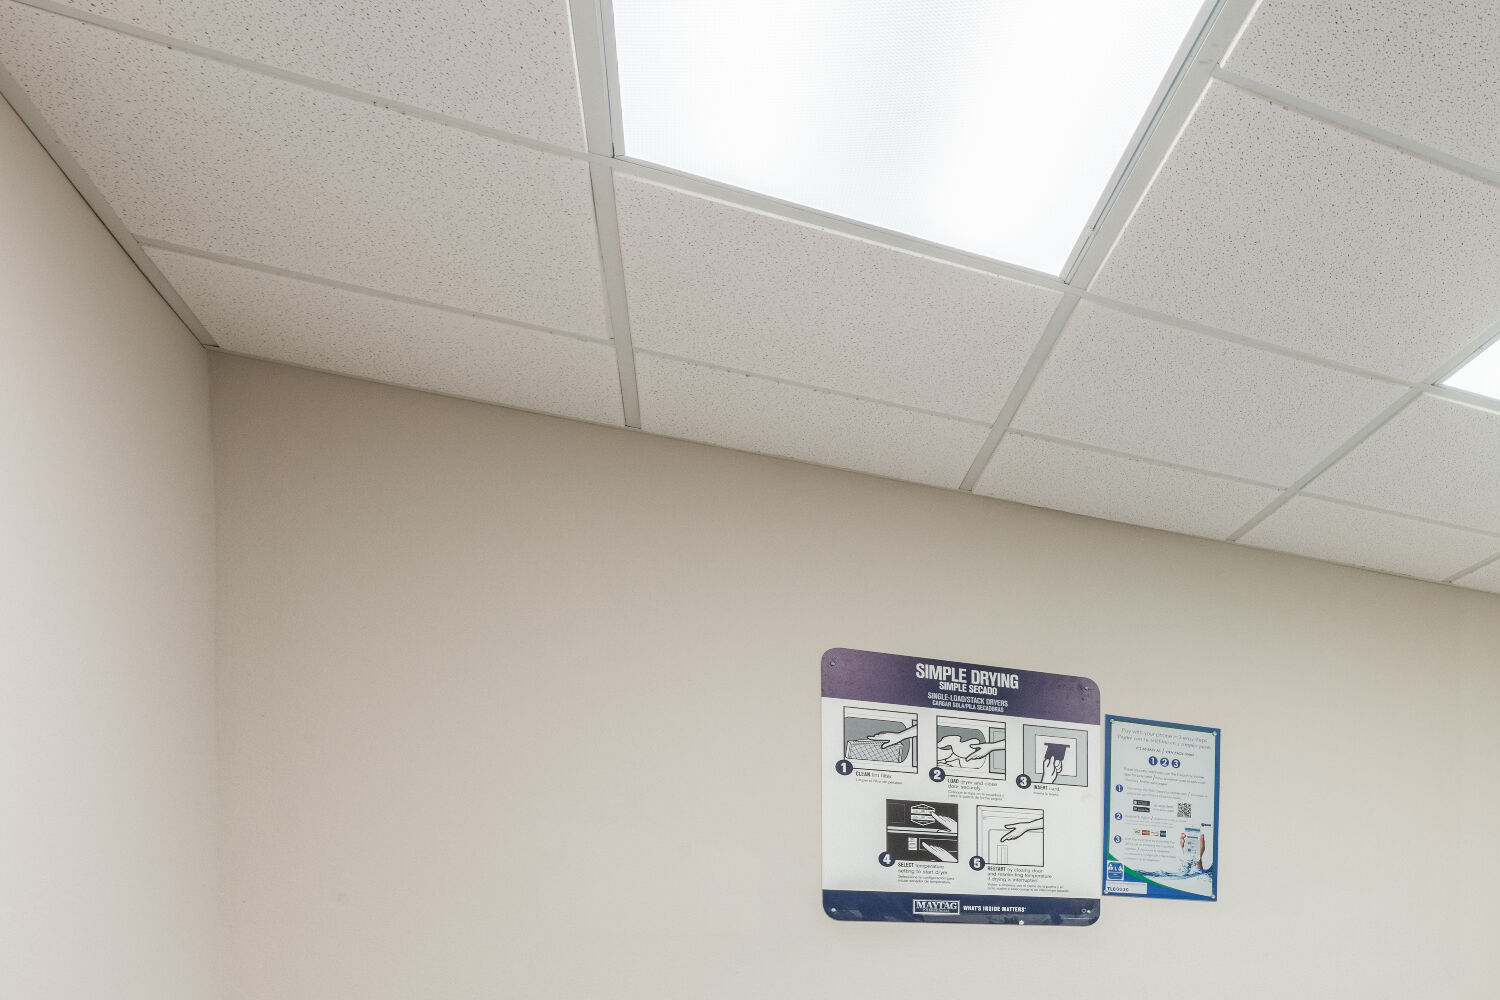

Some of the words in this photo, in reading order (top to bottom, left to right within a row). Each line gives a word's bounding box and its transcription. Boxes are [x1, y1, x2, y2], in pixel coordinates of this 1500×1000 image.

[916, 663, 967, 684] SIMPLE
[971, 669, 1019, 689] DRYING
[939, 682, 967, 692] SIMPLE
[969, 684, 997, 695] SECADO
[928, 692, 985, 705] SINGLE-LOAD/STACK
[986, 698, 1008, 707] DRYERS
[841, 763, 846, 772] 1
[933, 770, 941, 779] 2
[1020, 777, 1027, 786] 3
[882, 854, 891, 865] 4
[973, 858, 980, 868] 5
[916, 901, 957, 910] MAYTAG
